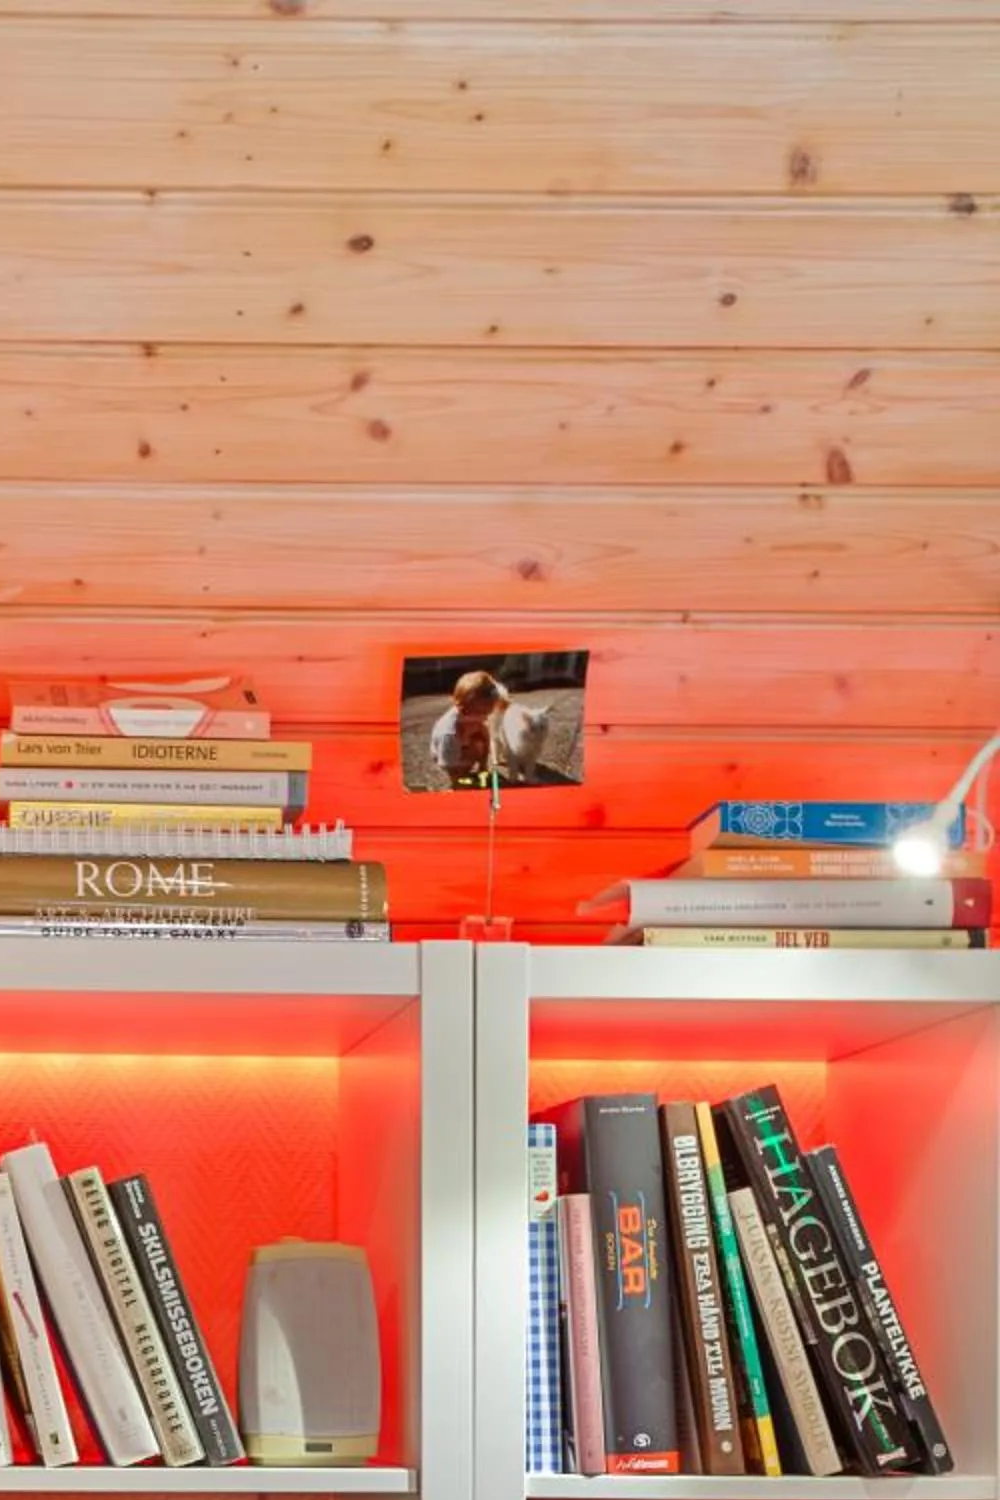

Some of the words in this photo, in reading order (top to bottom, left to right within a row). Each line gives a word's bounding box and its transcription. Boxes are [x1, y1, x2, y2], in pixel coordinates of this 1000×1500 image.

[17, 742, 43, 755] Lars
[46, 745, 71, 755] von
[76, 744, 102, 755] Trier
[132, 745, 218, 761] IDIOTERNE
[75, 861, 216, 898] ROME
[776, 931, 800, 948] HEL
[805, 932, 830, 948] VED
[672, 1135, 709, 1248] ØLBRYGGING
[619, 1205, 646, 1294] BAR
[692, 1253, 710, 1291] FRA
[753, 1128, 898, 1432] HAGEBOK
[104, 1239, 138, 1309] DIGITAL
[134, 1324, 184, 1434] NEGROPONTE
[136, 1221, 219, 1417] SKILSMISSEBOKEN
[698, 1294, 721, 1340] HÅND
[862, 1260, 926, 1401] PLANTELYKKE
[705, 1342, 725, 1375] TIL
[710, 1378, 733, 1431] MUNN
